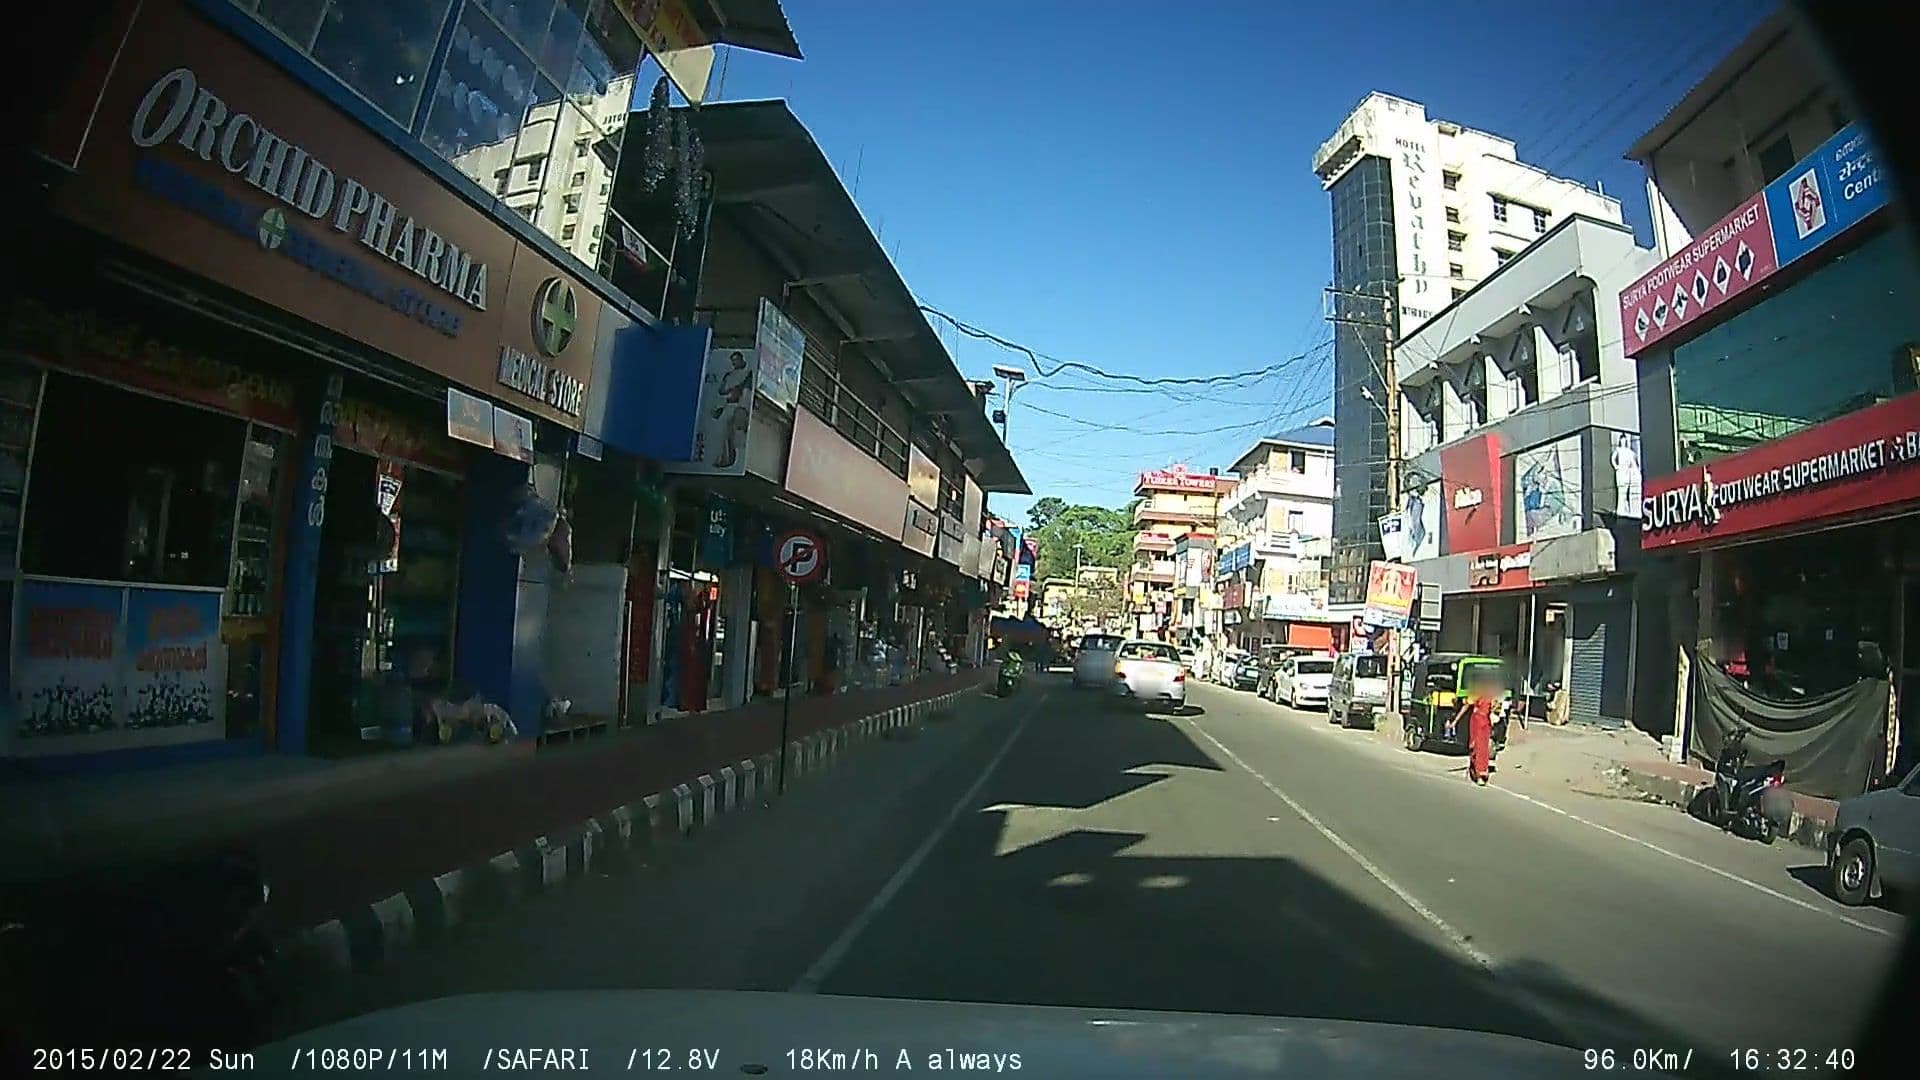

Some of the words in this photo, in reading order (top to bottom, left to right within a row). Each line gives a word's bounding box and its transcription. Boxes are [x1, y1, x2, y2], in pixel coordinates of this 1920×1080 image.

[131, 68, 335, 218] ORCHID
[333, 177, 488, 312] PHARMA
[1395, 136, 1426, 153] HOTEL
[1622, 282, 1648, 310] SURYA
[1648, 254, 1693, 294] FOOTWEAR
[1693, 204, 1760, 264] SUPERMARKET
[499, 346, 547, 400] MEDICAL
[550, 369, 584, 416] STORE
[1642, 483, 1703, 532] SURYA
[1712, 470, 1781, 507] FOOTWEAR
[1782, 439, 1885, 490] SUPERMARKET
